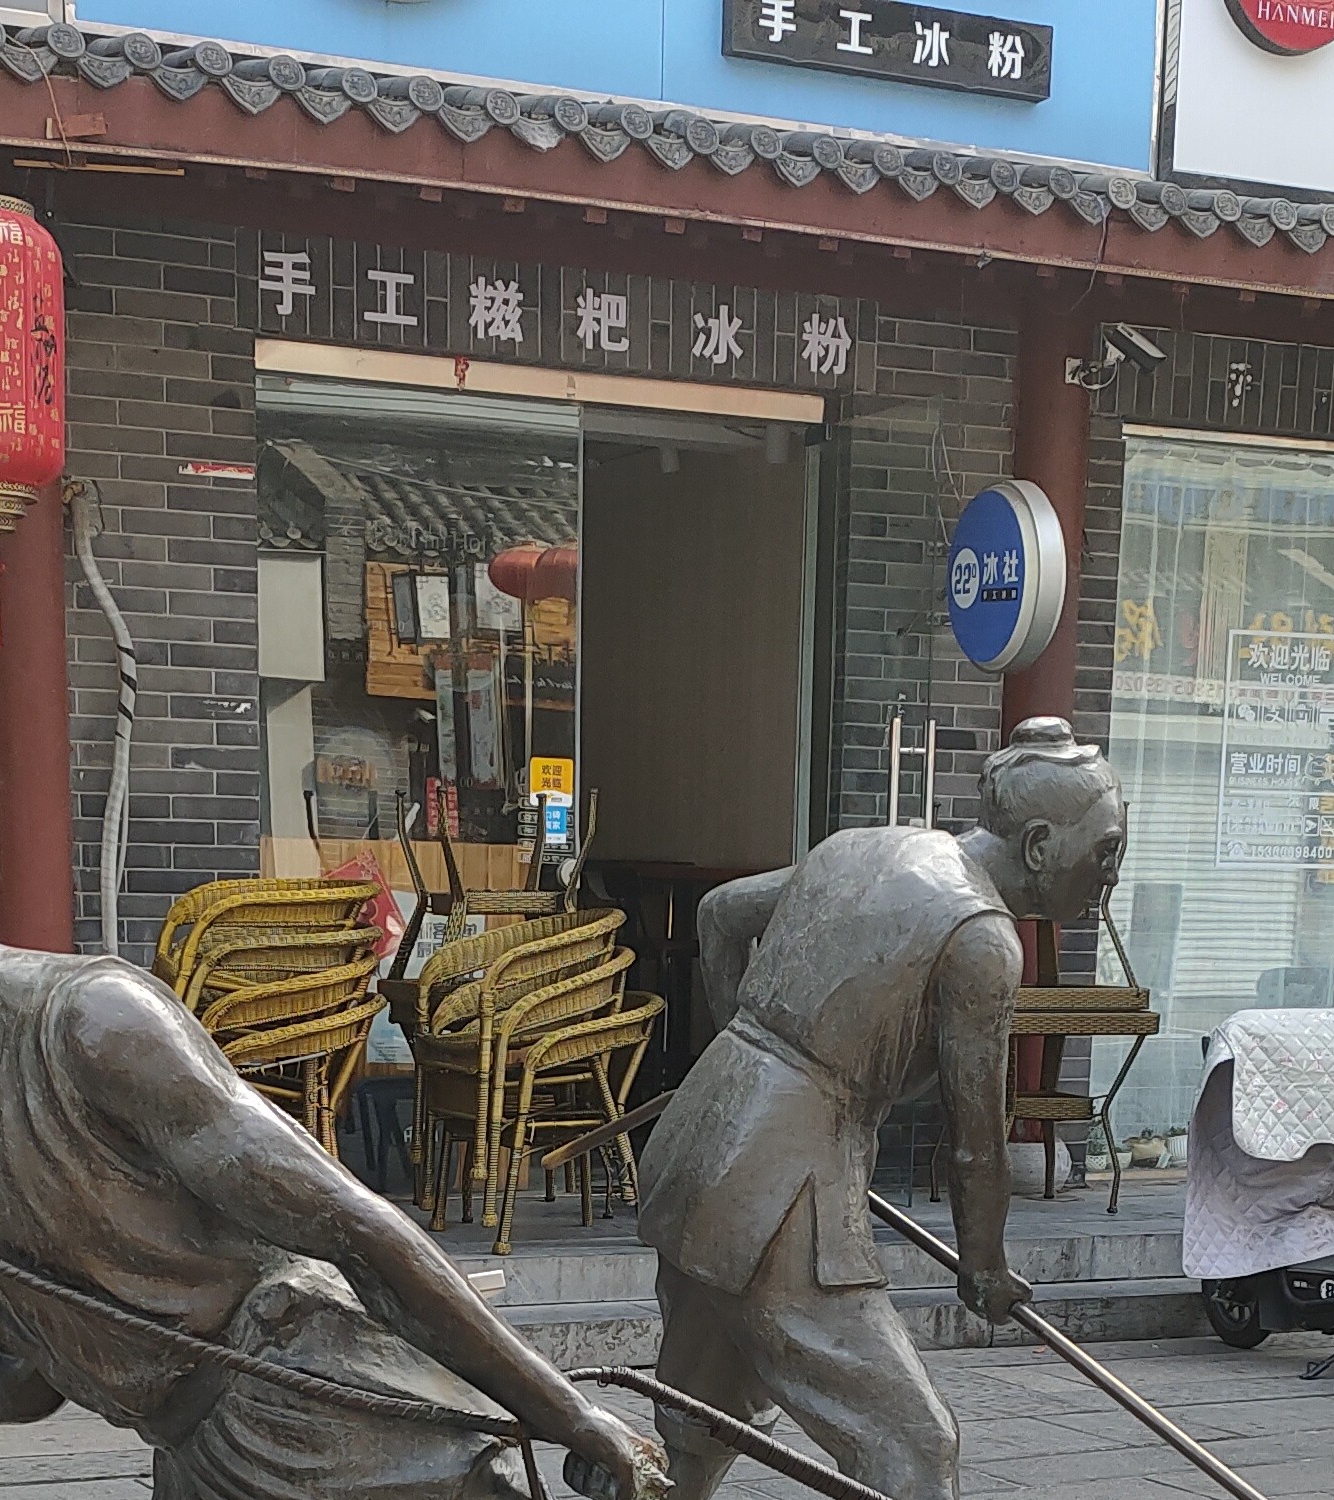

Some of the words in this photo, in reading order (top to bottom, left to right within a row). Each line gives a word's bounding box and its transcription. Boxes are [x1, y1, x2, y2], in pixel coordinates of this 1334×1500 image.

[758, 0, 1026, 80] 手工冰粉
[258, 250, 852, 376] 手工糍粑冰粉
[982, 549, 1019, 585] 冰社
[1248, 642, 1331, 672] 欢迎光临
[1259, 671, 1322, 687] WELCOME
[1230, 752, 1302, 776] 营业时间
